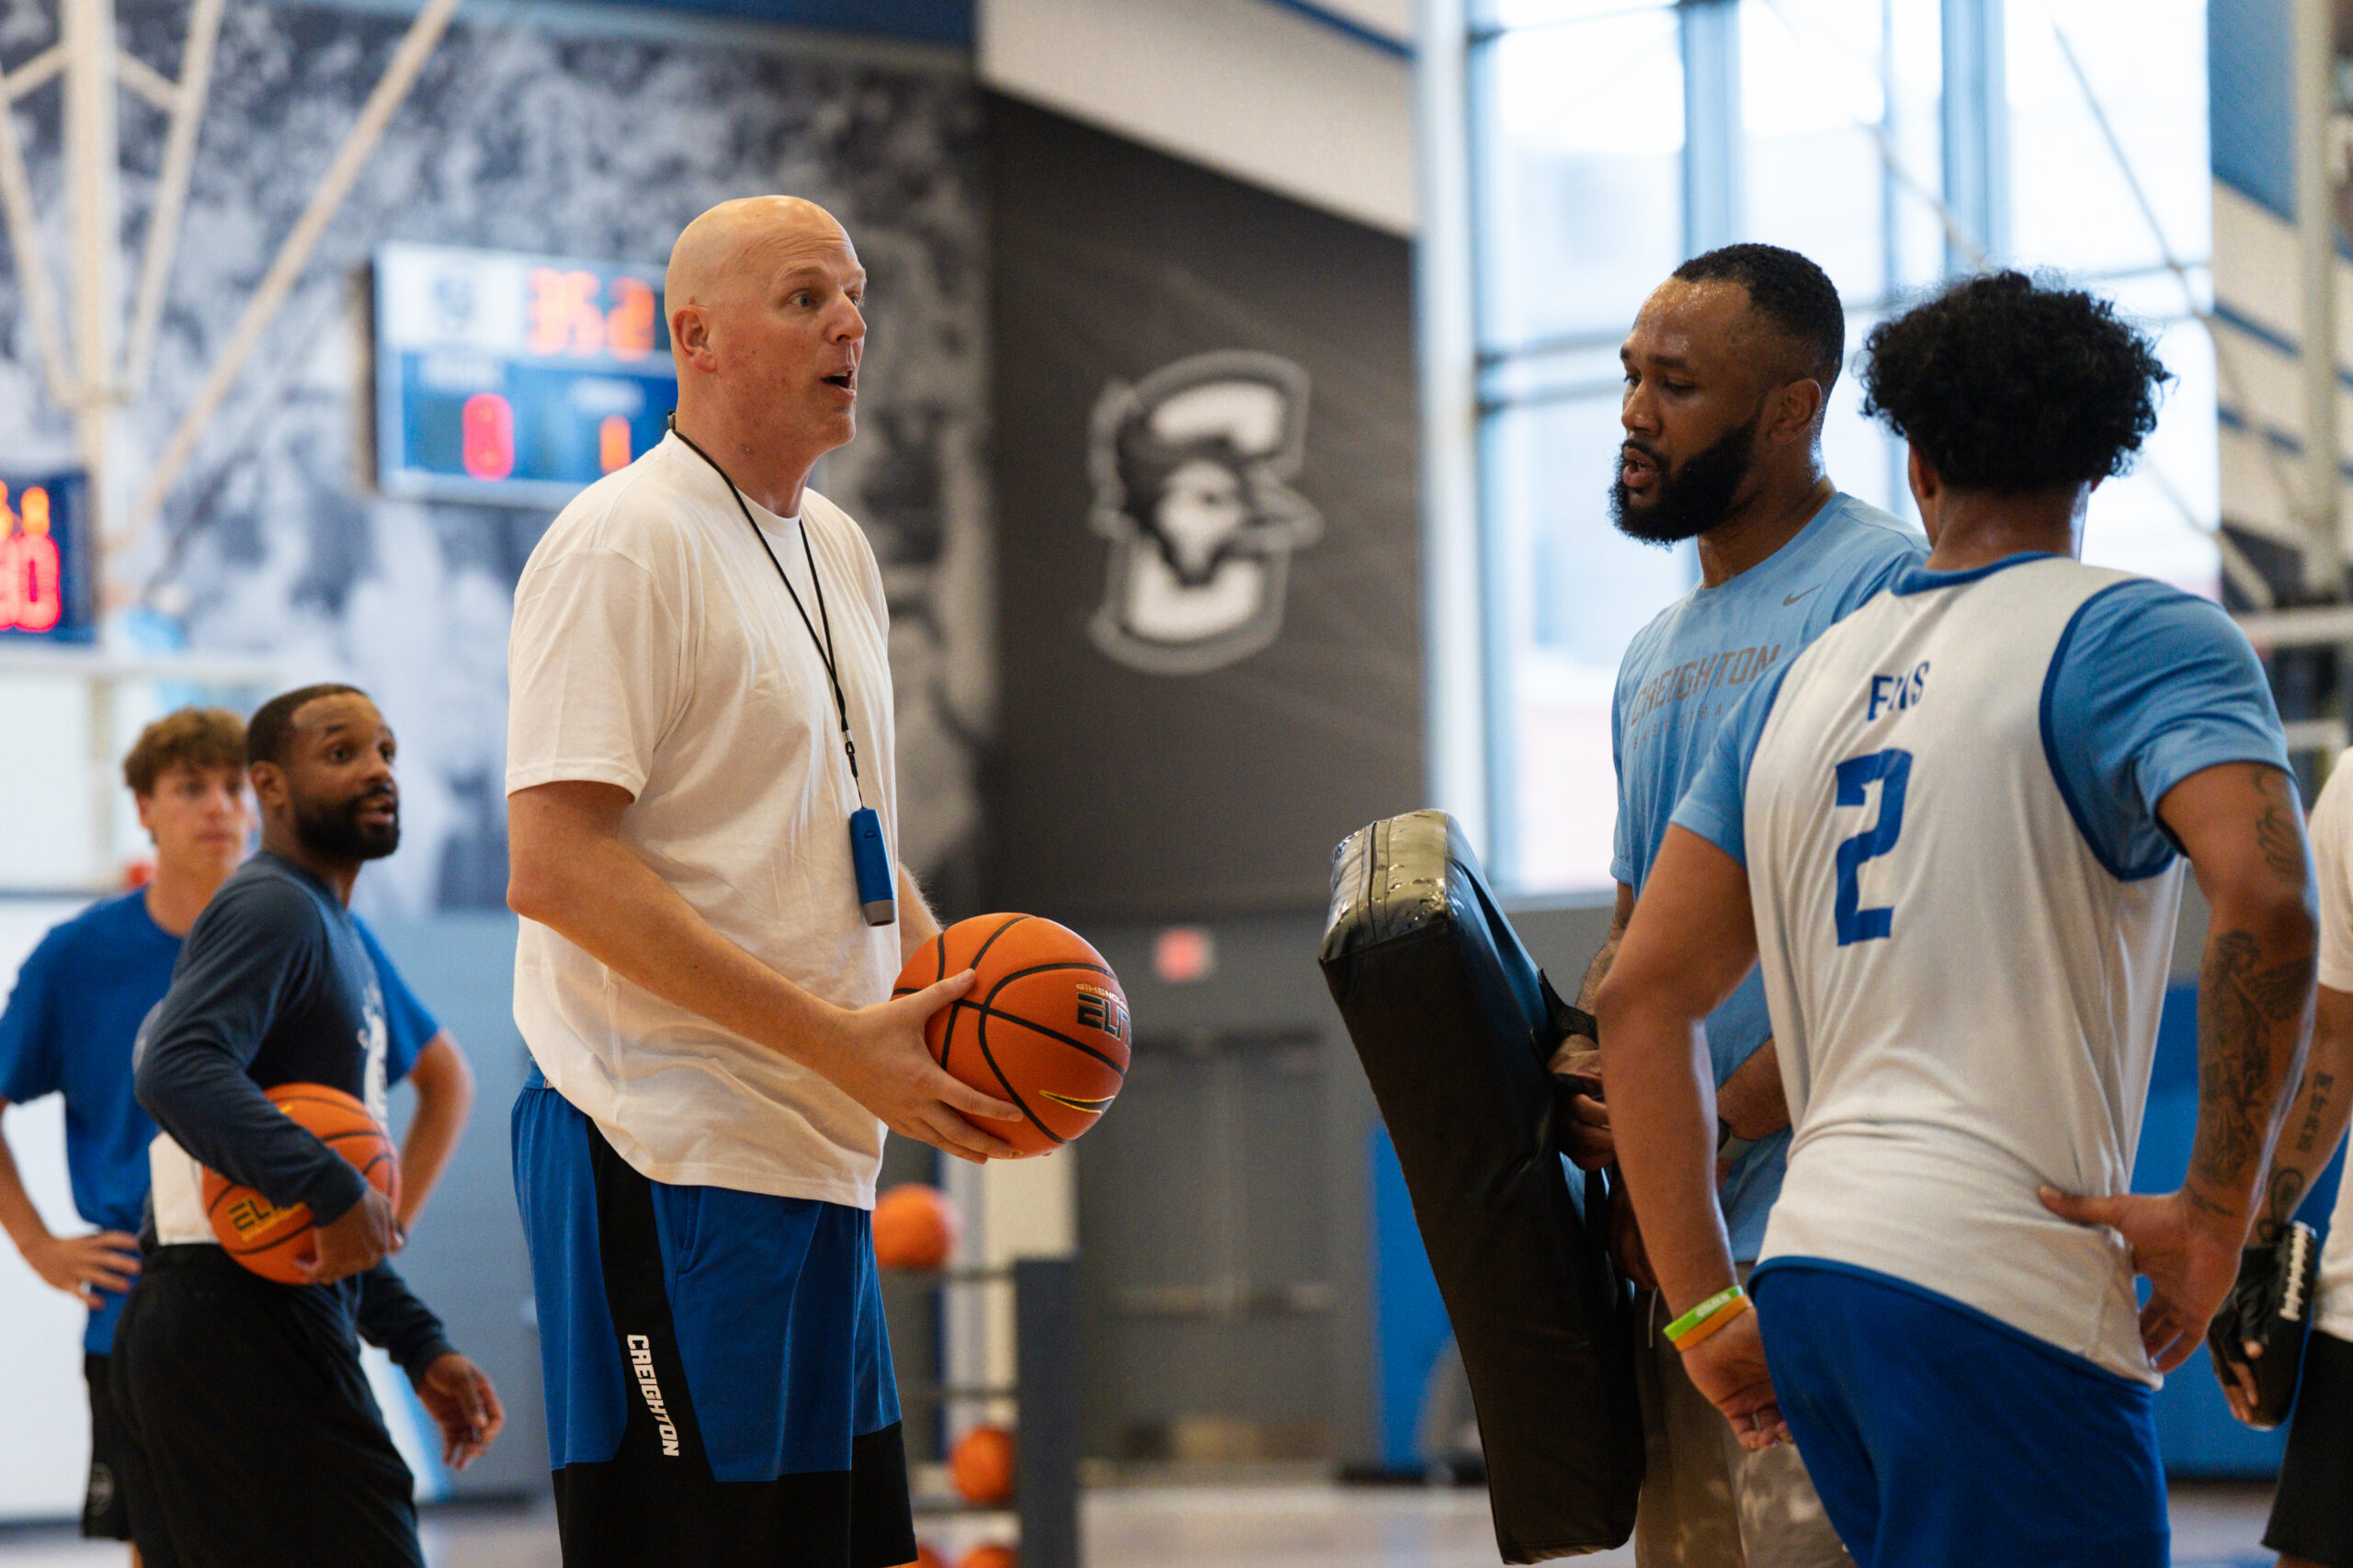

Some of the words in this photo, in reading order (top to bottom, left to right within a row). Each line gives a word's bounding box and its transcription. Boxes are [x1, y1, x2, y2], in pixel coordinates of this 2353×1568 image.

[1631, 644, 1781, 727] CREIGHTON
[1835, 748, 1914, 947] 2
[627, 1335, 679, 1457] CREIGHTON
